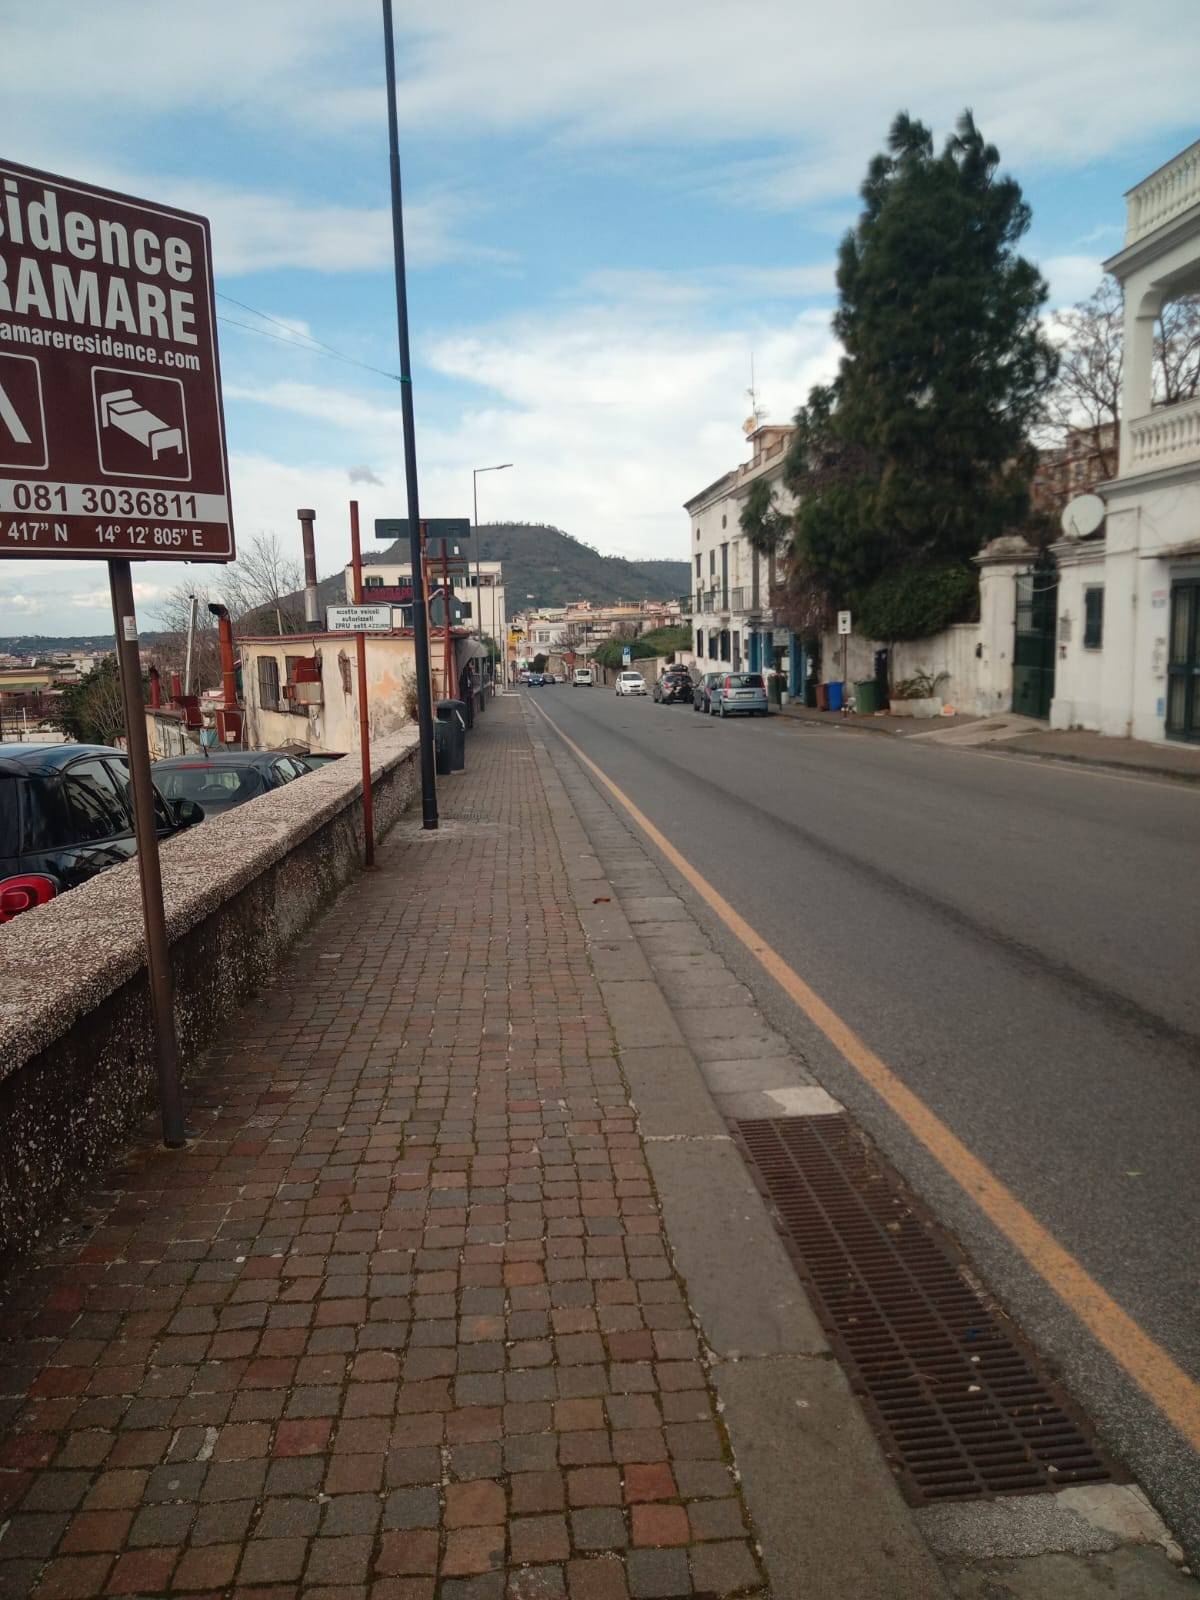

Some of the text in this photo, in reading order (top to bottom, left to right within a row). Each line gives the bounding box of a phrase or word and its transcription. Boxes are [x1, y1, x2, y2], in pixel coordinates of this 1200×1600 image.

[0, 179, 193, 283] idence
[13, 483, 197, 519] 081 3036811
[54, 523, 68, 542] N
[193, 529, 204, 547] E
